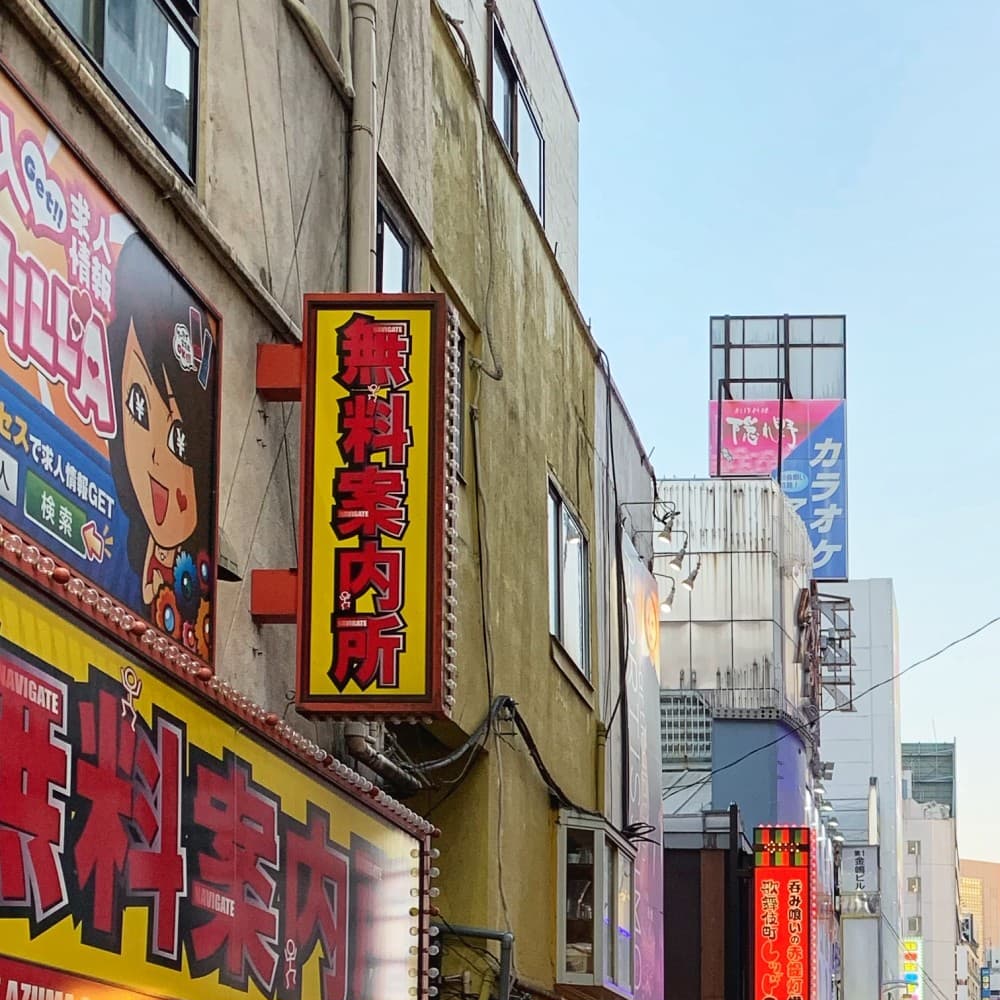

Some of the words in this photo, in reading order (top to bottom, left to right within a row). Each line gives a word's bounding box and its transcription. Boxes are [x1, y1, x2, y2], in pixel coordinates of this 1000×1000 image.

[40, 490, 73, 538] 検索
[332, 312, 414, 694] 無料案内所
[809, 437, 843, 569] カラオケ
